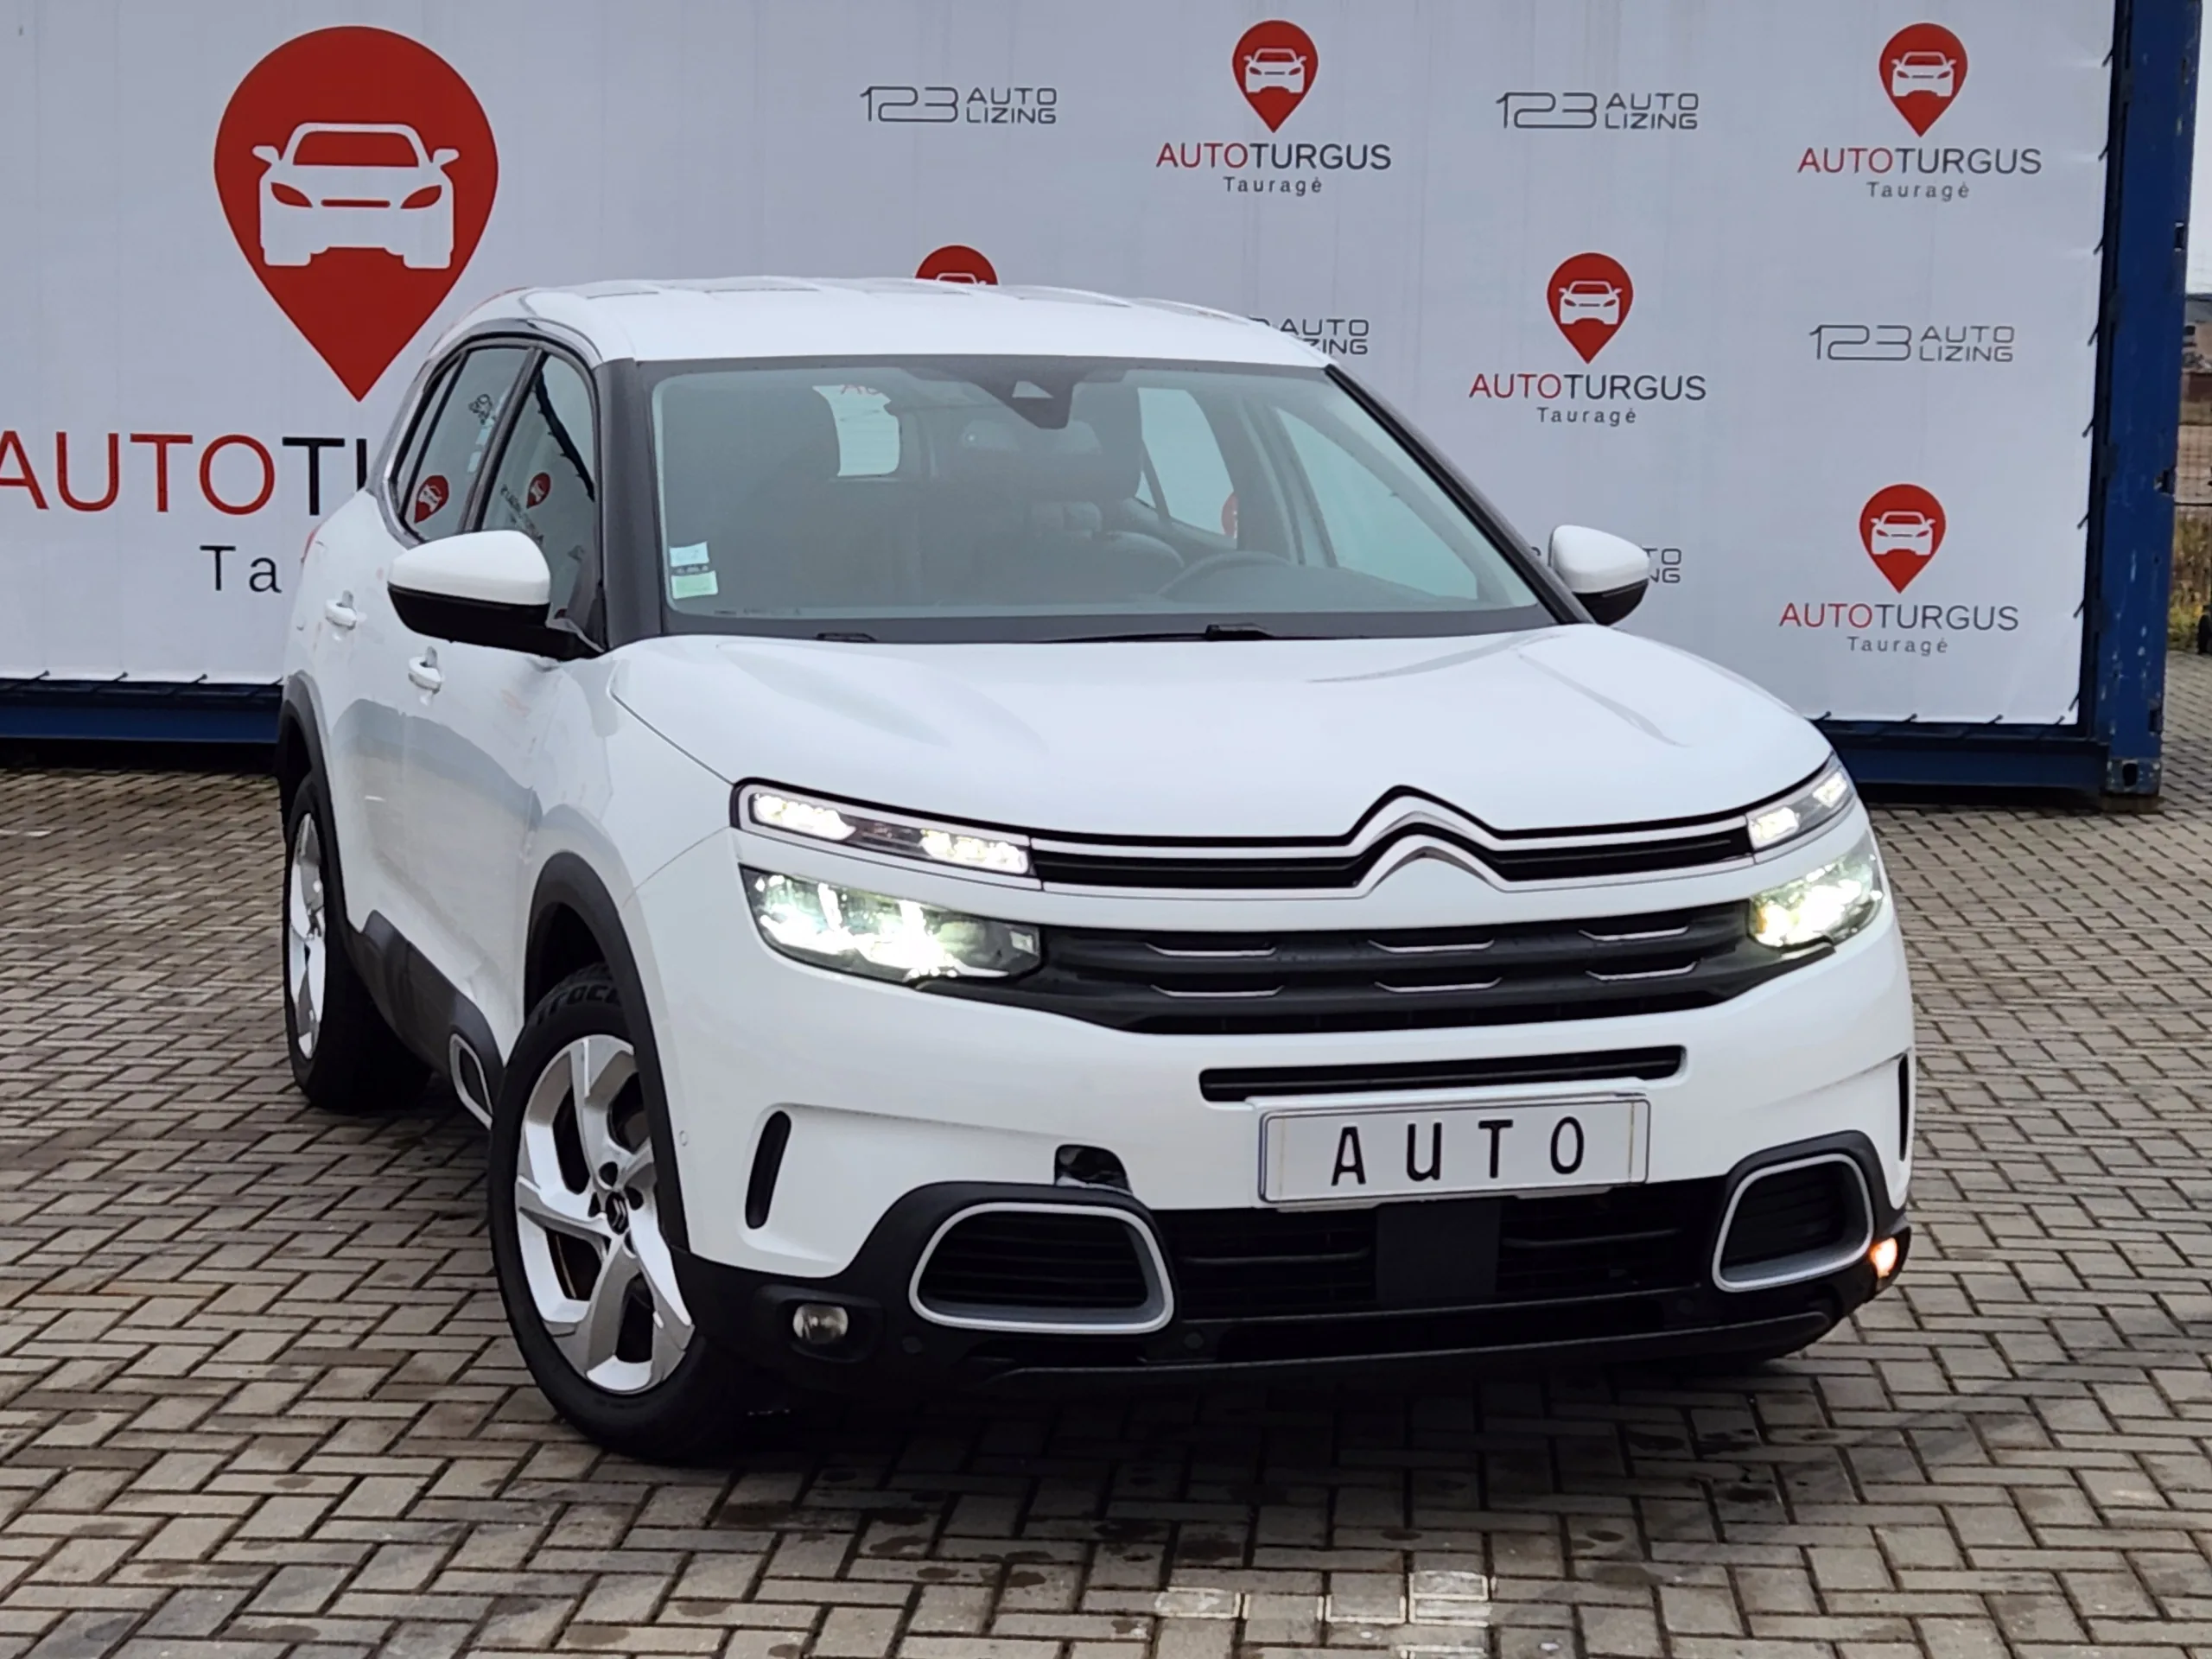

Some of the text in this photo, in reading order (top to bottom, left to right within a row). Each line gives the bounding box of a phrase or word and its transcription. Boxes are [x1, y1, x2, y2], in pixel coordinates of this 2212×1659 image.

[966, 87, 1057, 105] AUTO
[1605, 92, 1699, 111] AUTO
[966, 107, 1056, 124] LIZING
[1605, 112, 1697, 130] LIZING
[1156, 143, 1391, 170] AUTOTURGUS
[1797, 148, 2042, 175] AUTOTURGUS
[1280, 318, 1369, 336] AUTO
[1920, 326, 2014, 343] AUTO
[1919, 346, 2012, 362] LIZING
[1469, 373, 1706, 401] AUTOTURGUS
[1778, 602, 2018, 631] AUTOTURGUS
[1331, 1116, 1585, 1186] AUTO
